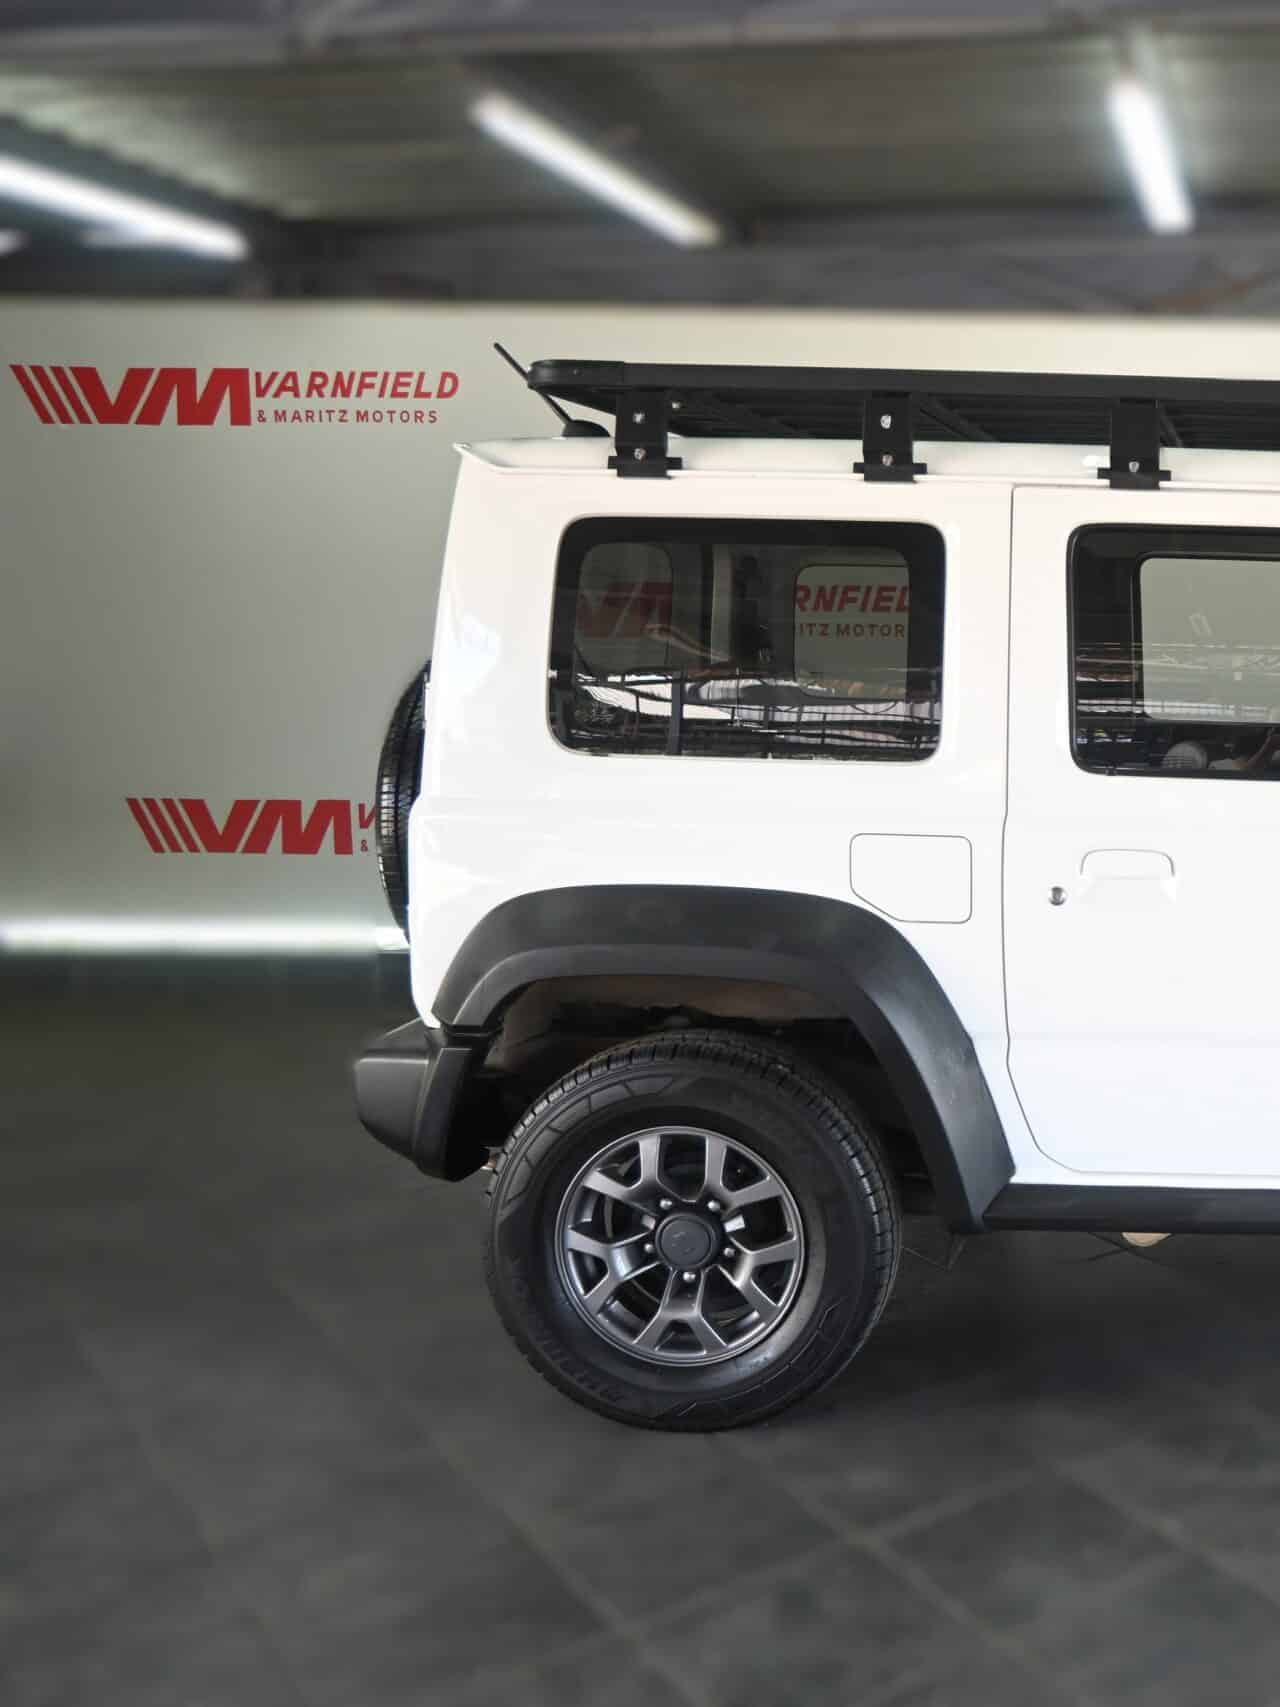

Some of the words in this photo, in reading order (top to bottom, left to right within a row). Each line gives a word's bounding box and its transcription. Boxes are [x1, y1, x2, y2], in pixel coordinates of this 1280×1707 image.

[69, 366, 251, 426] VM
[254, 370, 460, 399] VARNFIELD
[257, 410, 267, 423] &
[273, 409, 348, 423] MARITZ
[356, 410, 438, 424] MOTORS
[796, 585, 912, 612] RNFIEL
[837, 624, 905, 638] MOTOR
[178, 799, 353, 855] VM
